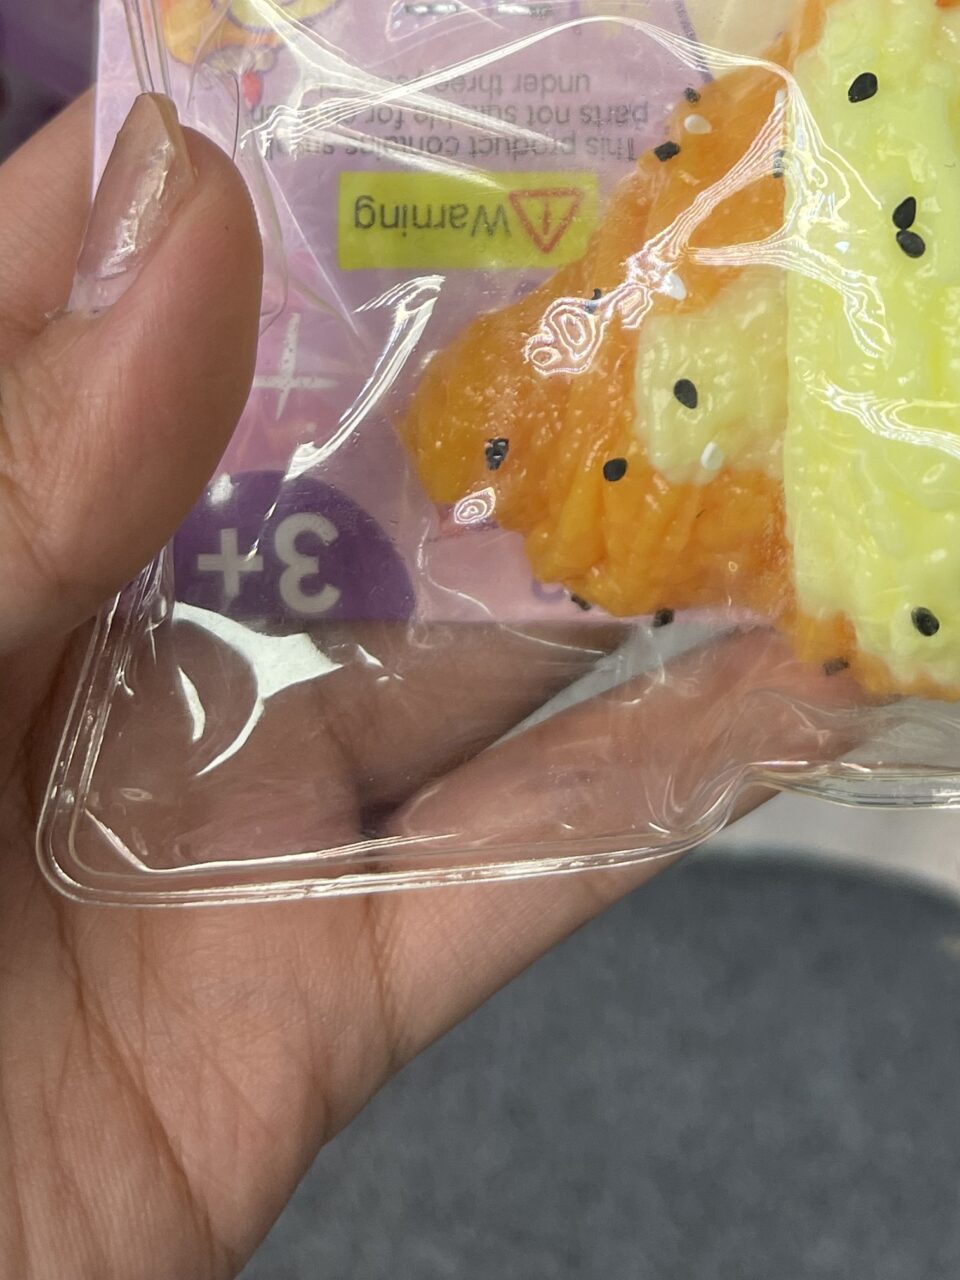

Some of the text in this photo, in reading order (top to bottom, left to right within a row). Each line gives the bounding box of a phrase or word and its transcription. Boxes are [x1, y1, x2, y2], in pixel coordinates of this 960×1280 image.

[512, 71, 591, 98] under
[365, 103, 403, 129] for
[527, 103, 571, 126] not
[581, 101, 649, 128] parts
[468, 131, 577, 162] product
[585, 135, 637, 161] This
[354, 195, 512, 238] Warning
[197, 512, 342, 614] 3+
